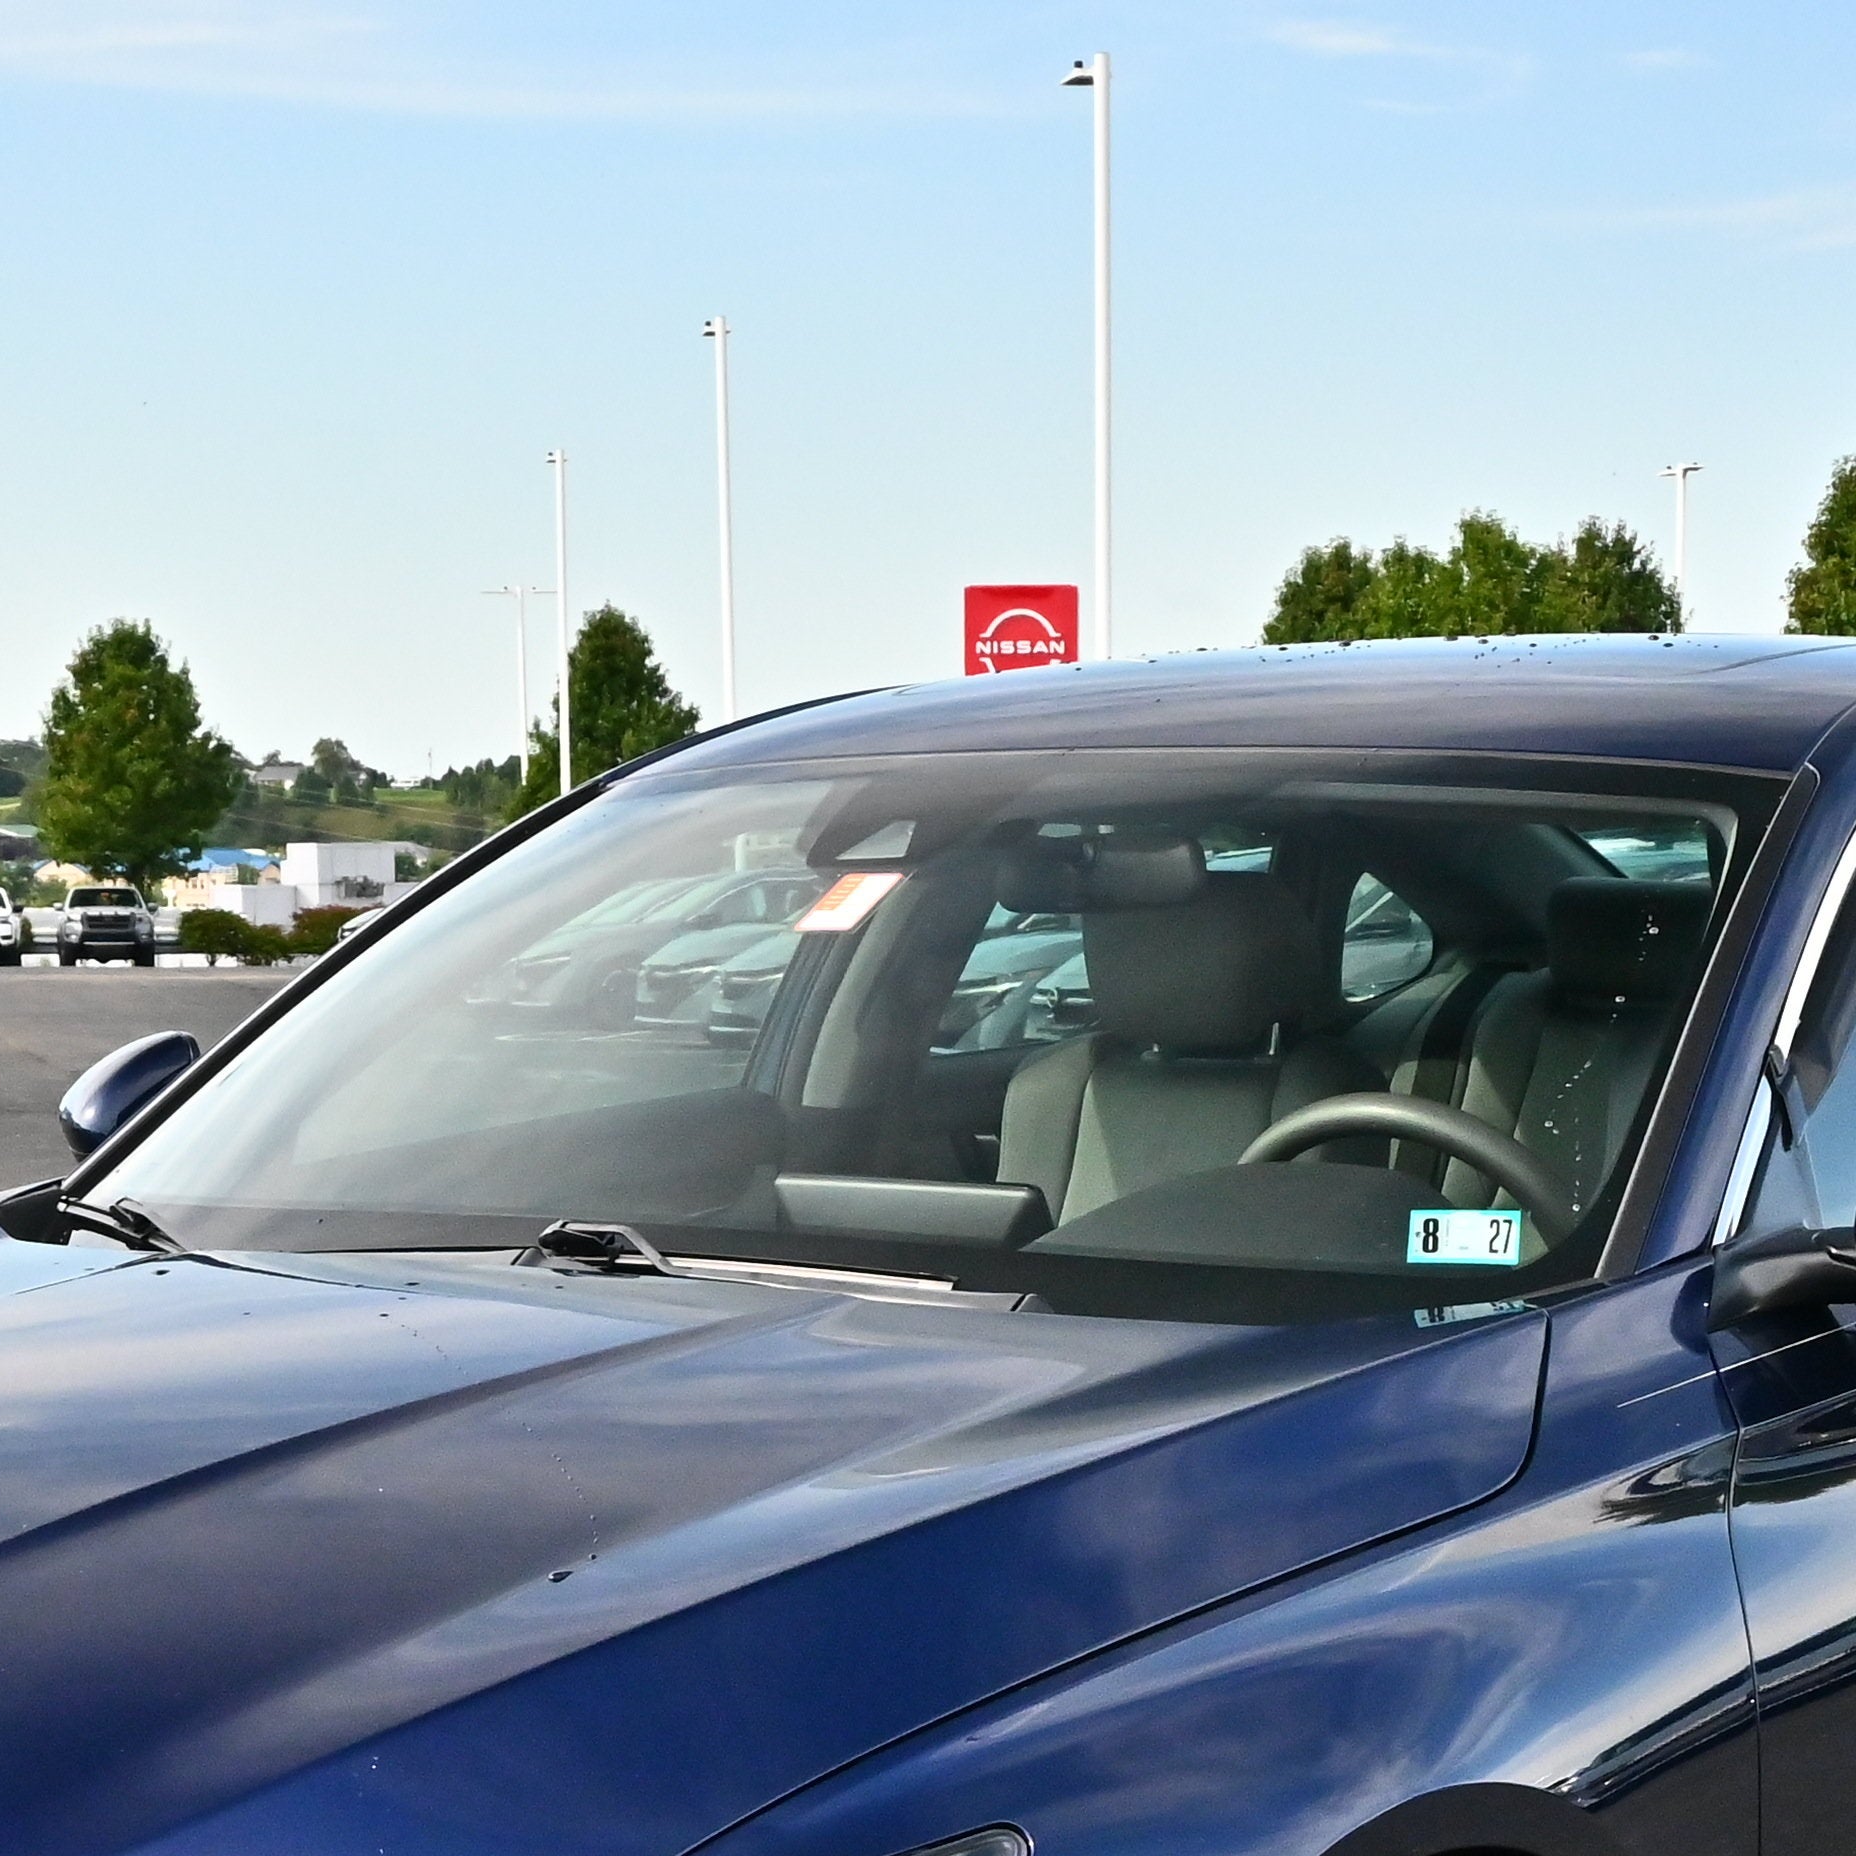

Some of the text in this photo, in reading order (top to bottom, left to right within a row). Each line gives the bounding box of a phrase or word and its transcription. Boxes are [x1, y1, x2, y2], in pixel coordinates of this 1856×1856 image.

[975, 640, 1066, 655] NISSAN
[1422, 1217, 1440, 1253] 8
[1488, 1219, 1513, 1254] 27
